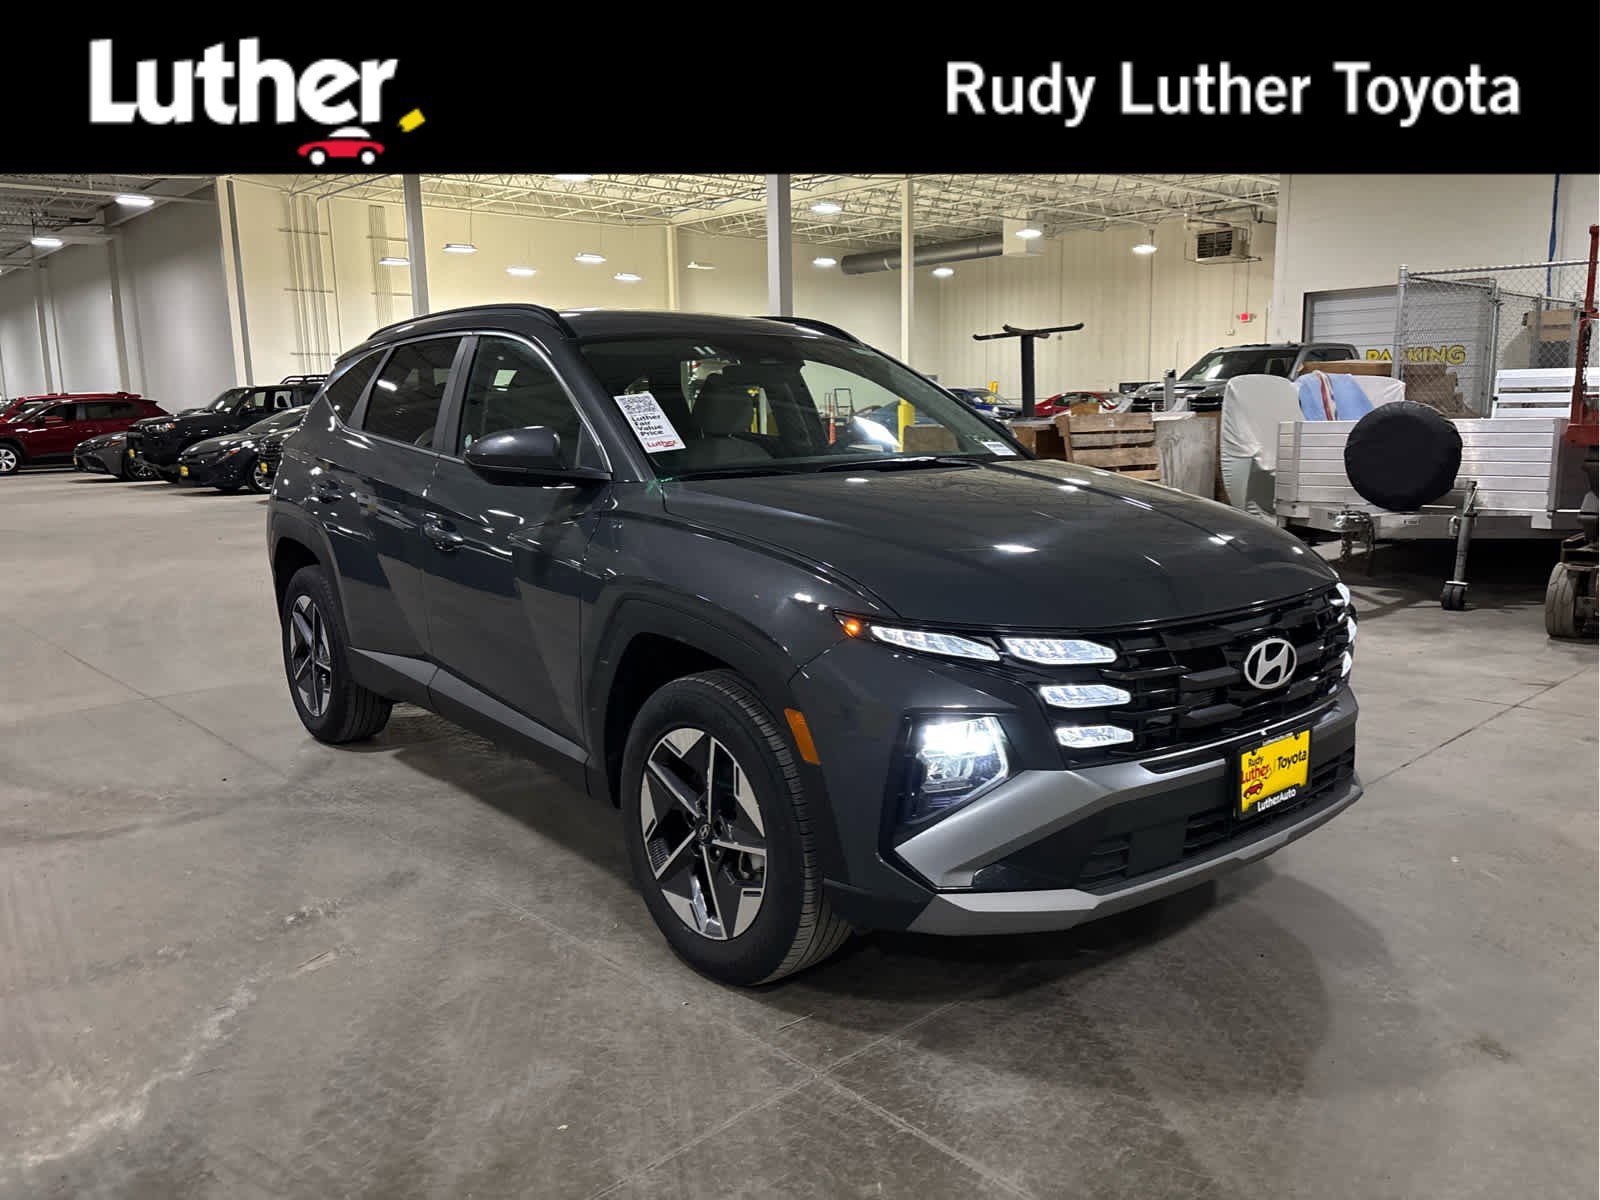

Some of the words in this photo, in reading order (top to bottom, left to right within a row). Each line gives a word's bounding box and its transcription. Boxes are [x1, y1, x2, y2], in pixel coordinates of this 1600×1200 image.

[1366, 345, 1466, 365] PAKING
[646, 440, 675, 448] Luther
[1277, 750, 1307, 770] Toyota
[1257, 788, 1297, 812] LutherAuto
